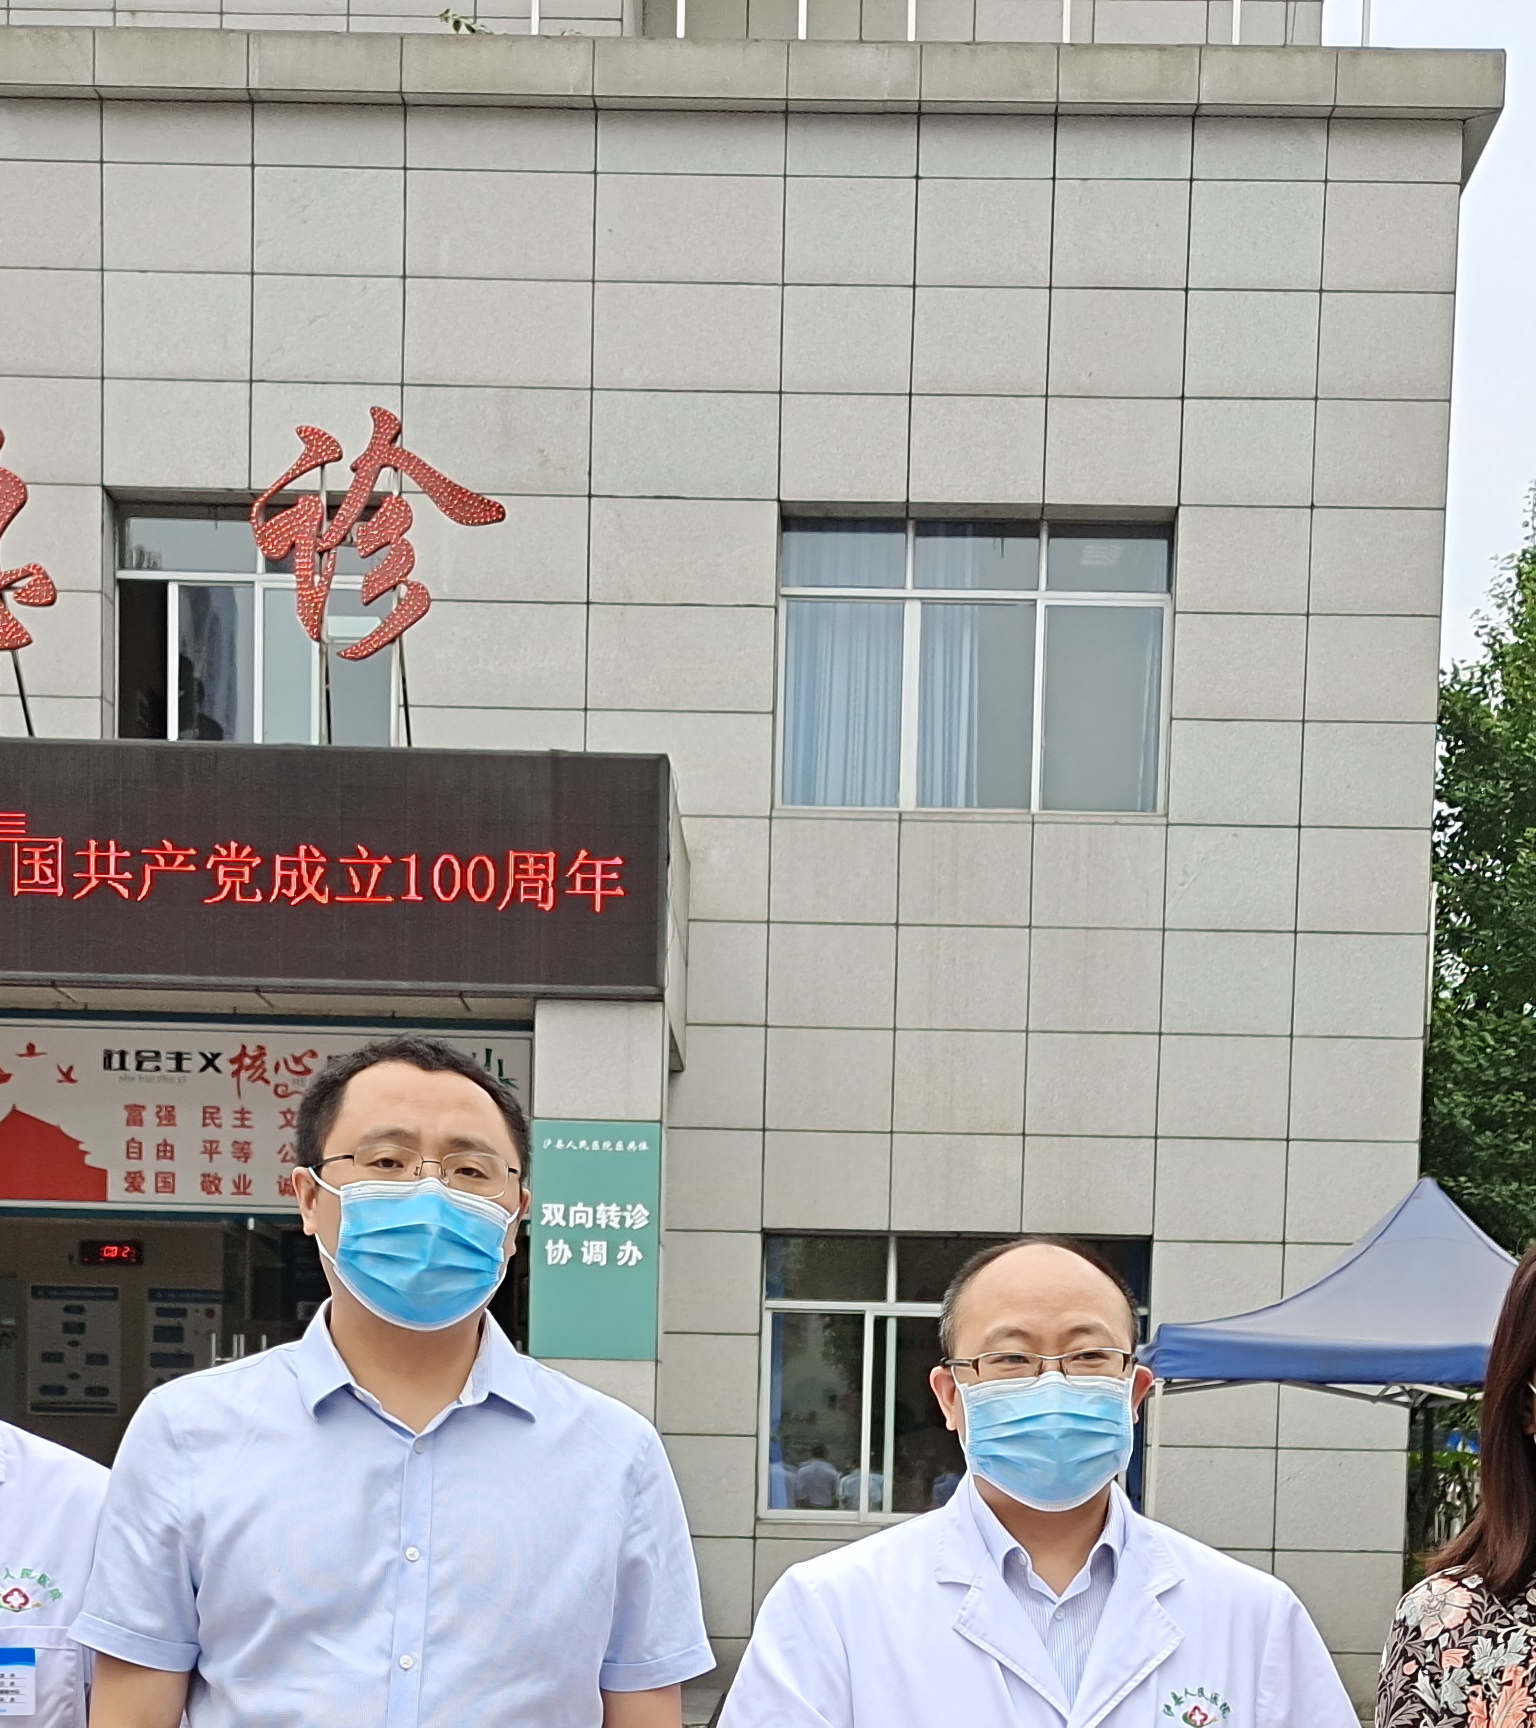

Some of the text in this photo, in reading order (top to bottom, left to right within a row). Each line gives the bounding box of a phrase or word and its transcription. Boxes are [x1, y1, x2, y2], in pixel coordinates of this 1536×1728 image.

[123, 1103, 178, 1128] 富强
[202, 1105, 254, 1130] 民主
[125, 1137, 176, 1162] 自由
[200, 1139, 254, 1164] 平等
[123, 1170, 176, 1194] 爱国
[200, 1172, 254, 1196] 敬业
[540, 1202, 650, 1230] 双向转诊
[545, 1238, 643, 1267] 协调办
